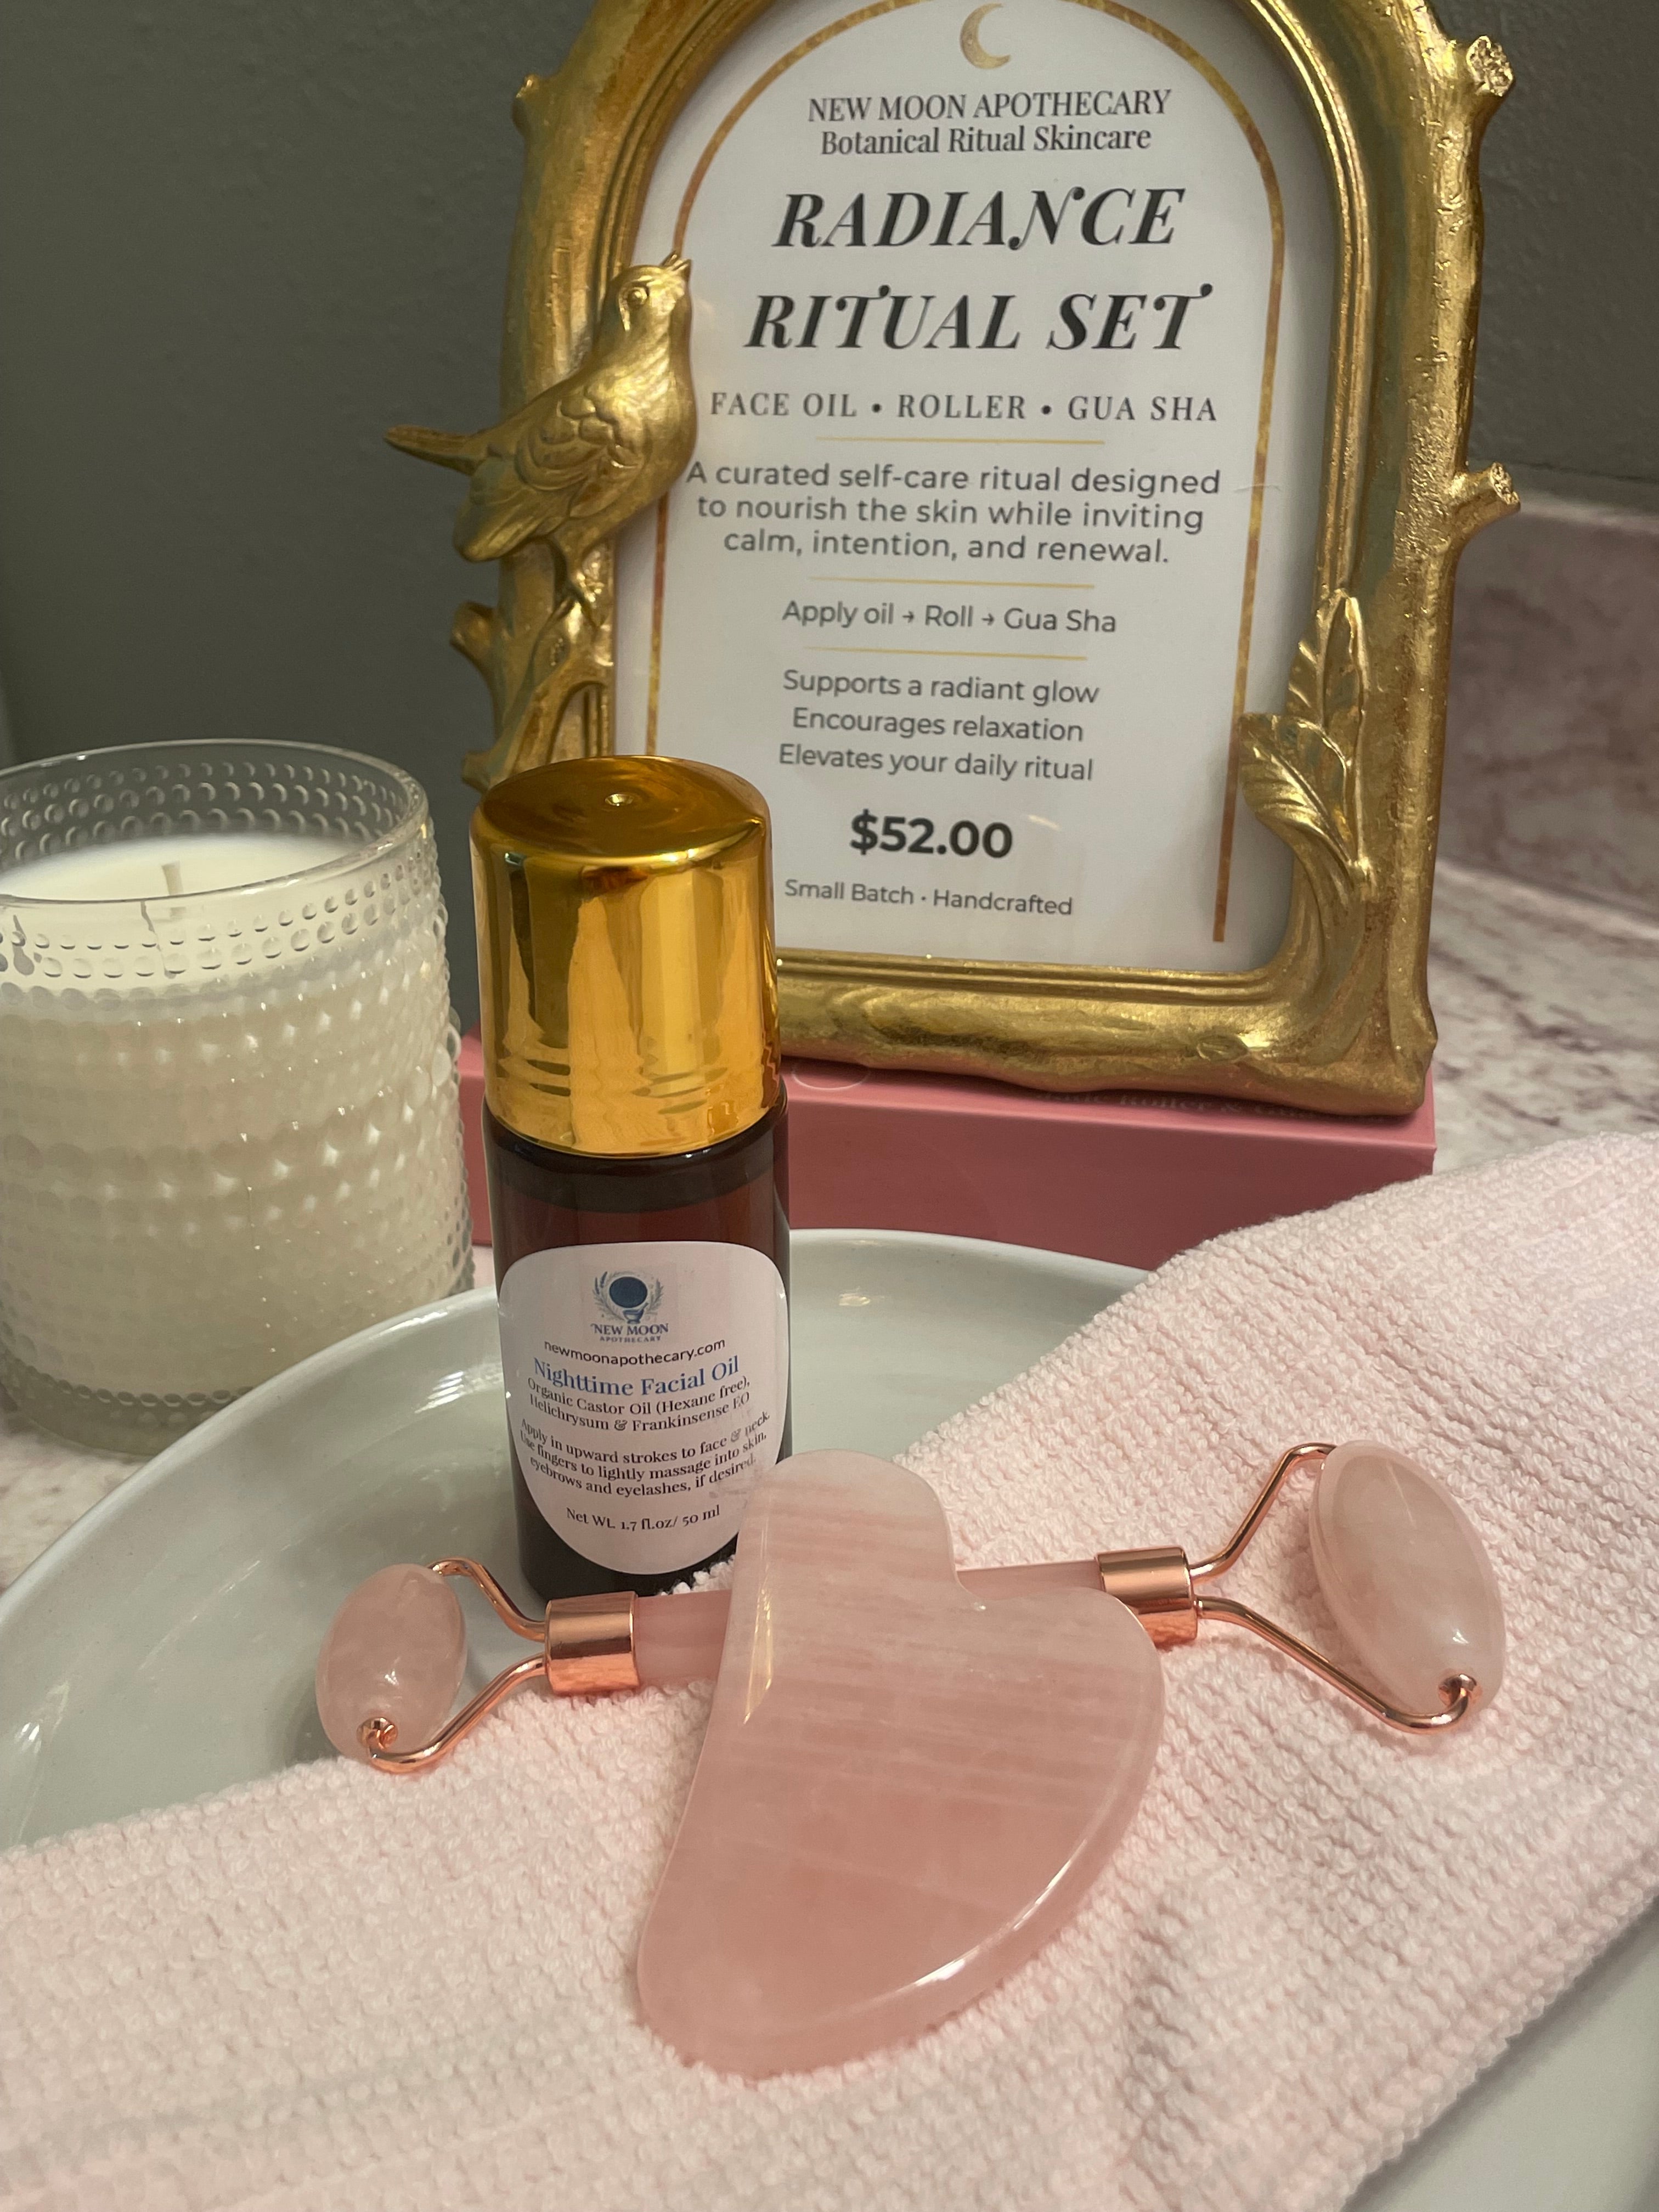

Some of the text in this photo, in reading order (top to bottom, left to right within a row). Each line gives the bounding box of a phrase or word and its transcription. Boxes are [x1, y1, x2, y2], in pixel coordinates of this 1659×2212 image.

[809, 89, 1171, 122] NEW MOON APOTHECARY
[822, 124, 1151, 155] Botanical Ritual Skincare
[771, 187, 1186, 251] RADIANCE
[744, 284, 1212, 350] RITUAL SET
[711, 392, 1216, 421] FACE OIL ROLLER GUA SHA
[686, 461, 1220, 499] A curated self-care ritual designed
[698, 496, 1203, 535] to nourish the skin while inviting
[724, 528, 1167, 563] calm, intention, and renewal.
[782, 600, 1116, 633] Apply oil Roll Gua Sha
[783, 669, 1099, 707] Supports a radiant glow
[793, 707, 1083, 742] Encourages relaxation
[780, 743, 1092, 781] Elevates your daily ritual
[850, 809, 1013, 859] $52.00
[785, 879, 1073, 915] Small Batch Handcrafted
[590, 1323, 669, 1335] NEW MOON
[544, 1339, 725, 1367] newmoonapothecary.com
[534, 1355, 738, 1396] Nighttime Facial Oil
[528, 1378, 573, 1407] Organic
[577, 1398, 625, 1414] Castor
[630, 1402, 651, 1414] Oil
[657, 1393, 715, 1415] (Hexane
[530, 1393, 609, 1430] Helichrysum
[614, 1419, 628, 1431] &
[633, 1403, 729, 1431] Frankinsense
[522, 1419, 548, 1444] Apply
[551, 1435, 562, 1451] in
[566, 1444, 618, 1463] upward
[623, 1451, 677, 1464] strokes
[682, 1448, 695, 1459] to
[700, 1437, 727, 1454] face
[531, 1457, 582, 1488] eyebrows
[586, 1482, 612, 1494] and
[616, 1481, 691, 1497] eyelashes,
[695, 1475, 706, 1488] if
[538, 1444, 577, 1471] fingers
[581, 1463, 594, 1475] to
[599, 1466, 645, 1481] lightly
[650, 1459, 711, 1479] massage
[715, 1448, 740, 1465] into
[566, 1507, 589, 1524] Net
[621, 1521, 637, 1531] 1.7
[682, 1514, 698, 1527] 50
[702, 1505, 720, 1520] ml
